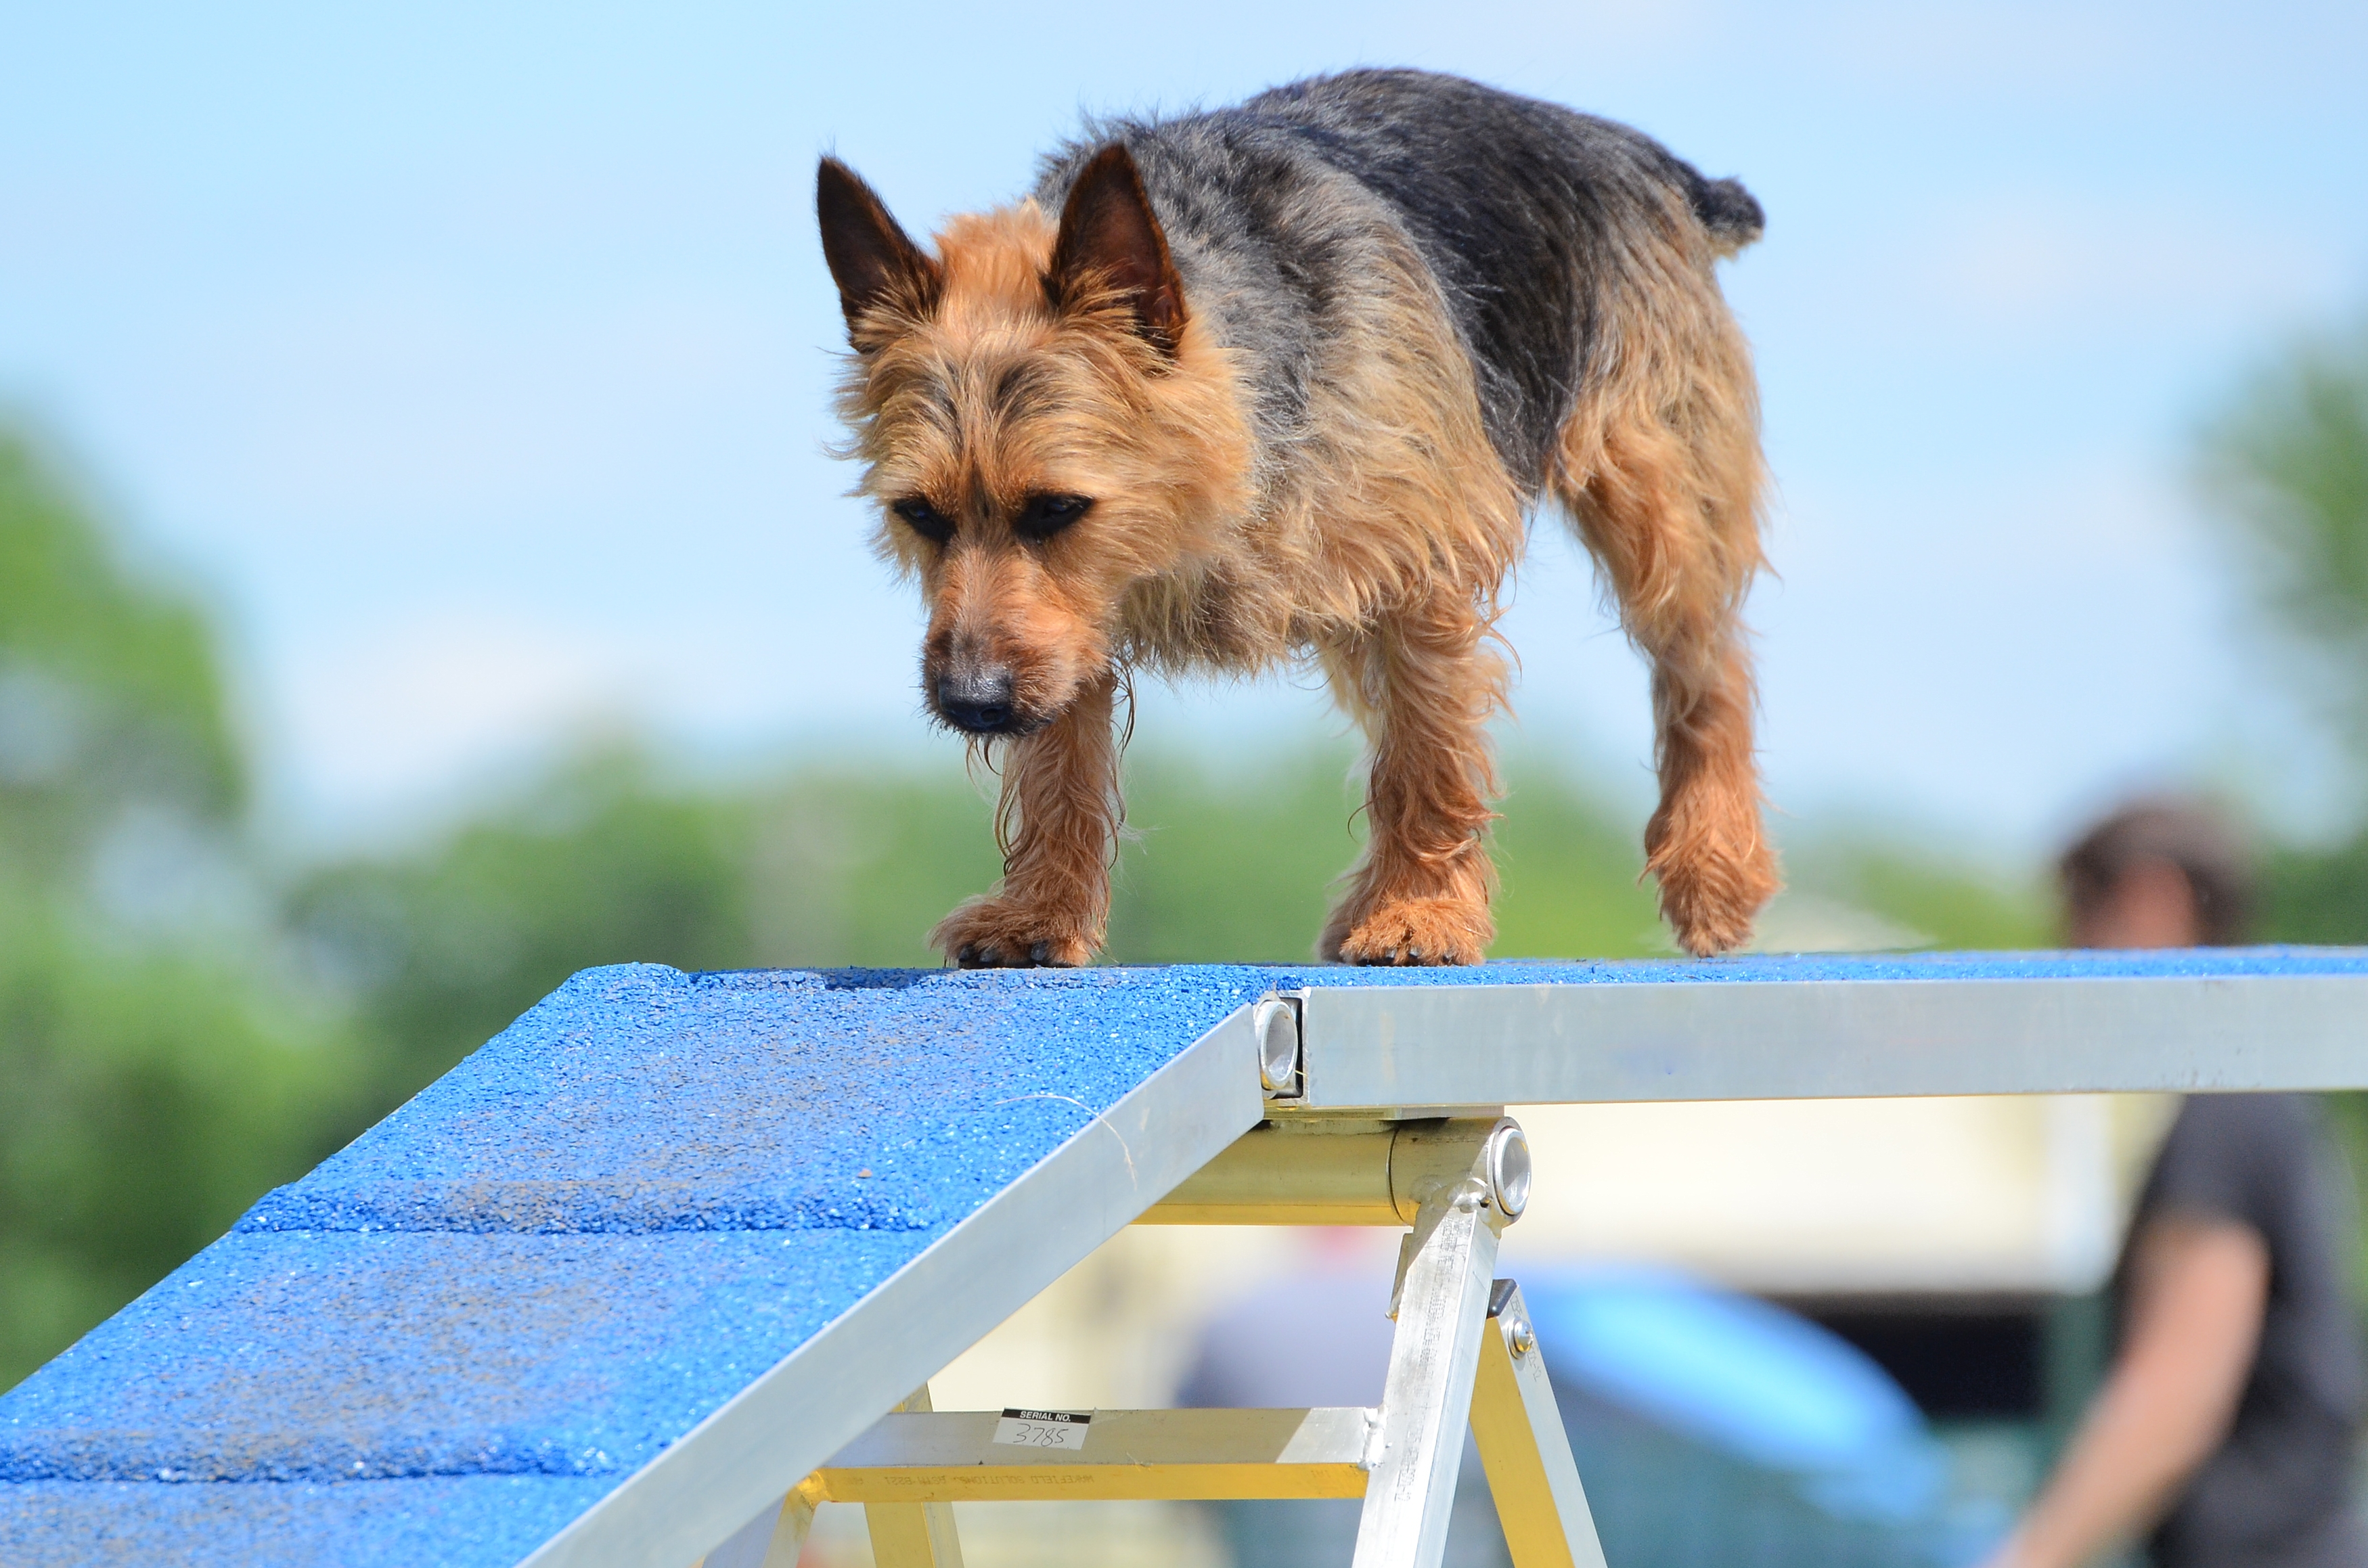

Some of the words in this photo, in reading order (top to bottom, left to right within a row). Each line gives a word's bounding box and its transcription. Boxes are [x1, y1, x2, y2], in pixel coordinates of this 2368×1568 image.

[1019, 1410, 1053, 1421] SERIAL
[1055, 1414, 1071, 1422] NO.
[1013, 1423, 1069, 1447] 3785
[1030, 1475, 1095, 1484] WAKEFIELD
